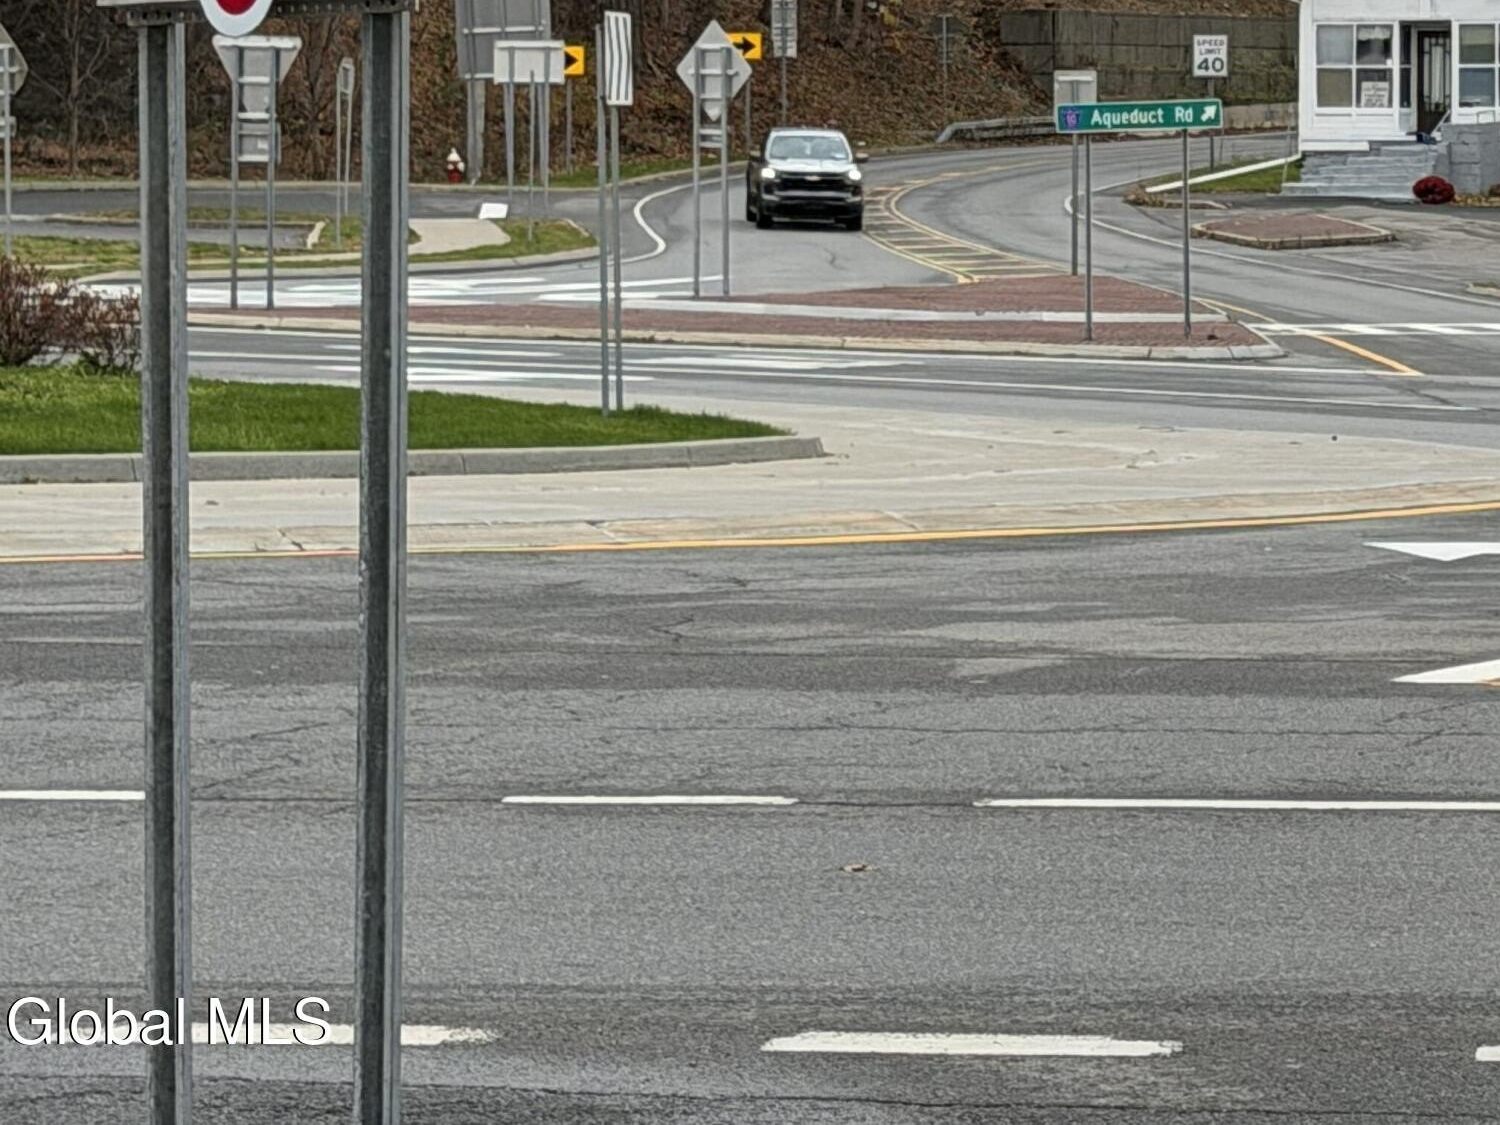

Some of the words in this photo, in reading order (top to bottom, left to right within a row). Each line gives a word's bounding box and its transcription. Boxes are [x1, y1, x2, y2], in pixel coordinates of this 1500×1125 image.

[1196, 38, 1225, 47] SPEED
[1199, 47, 1223, 56] LIMIT
[1197, 56, 1225, 73] 40
[1090, 107, 1165, 128] Aqueduct
[1174, 106, 1194, 122] Rd
